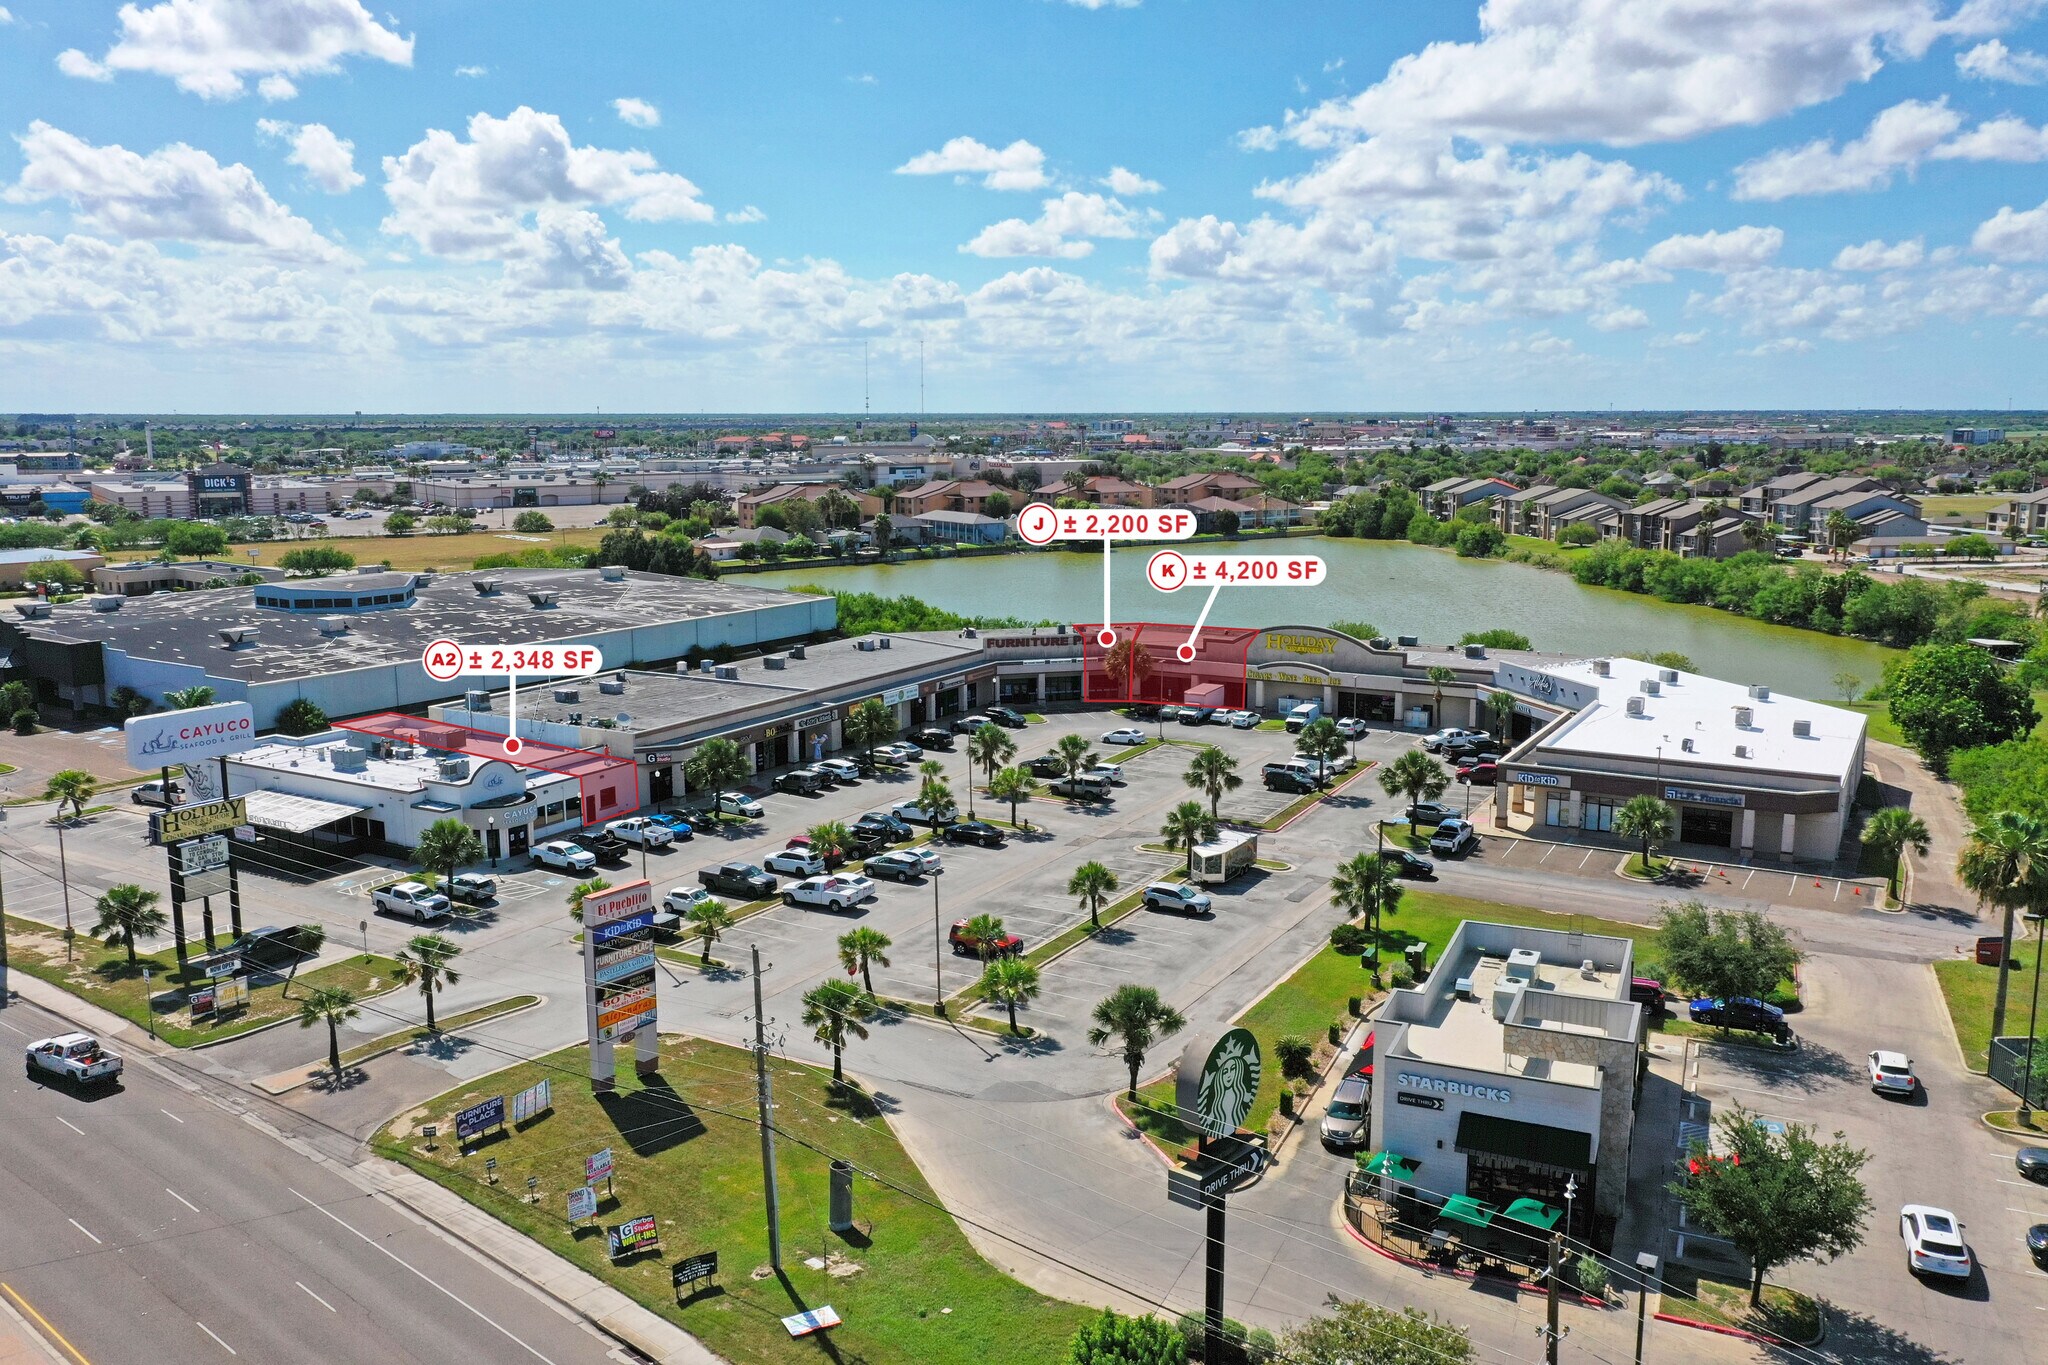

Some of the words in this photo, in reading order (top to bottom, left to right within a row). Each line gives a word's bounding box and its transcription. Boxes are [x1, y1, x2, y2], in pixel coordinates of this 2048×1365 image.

[204, 476, 236, 488] DICK'S
[986, 637, 1069, 649] FURNITURE
[1265, 633, 1339, 654] HOLIDAY
[1277, 671, 1298, 682] WINE
[1303, 675, 1323, 686] BEER
[179, 718, 250, 740] CAYUCO
[765, 728, 776, 738] BO
[180, 738, 217, 750] SEAFOOD
[229, 732, 252, 742] GRILL
[647, 754, 656, 763] G
[161, 799, 243, 834] HOLIDAY
[213, 823, 228, 831] BEER
[187, 844, 209, 853] COOLEST
[597, 903, 607, 916] El
[609, 892, 647, 914] Pueblito
[596, 947, 632, 966] FURNITURE
[221, 961, 235, 971] OPEN
[190, 996, 199, 1004] G
[603, 996, 620, 1008] BO
[1397, 1073, 1511, 1103] STARBUCKS
[1399, 1095, 1416, 1103] DRIVE
[1417, 1098, 1433, 1106] THRU
[456, 1097, 503, 1123] FURNITURE
[468, 1108, 496, 1126] PLACE
[1204, 1173, 1228, 1196] DRIVE
[1229, 1160, 1250, 1180] THRU
[632, 1216, 654, 1225] Barber
[622, 1225, 632, 1237] G
[633, 1223, 655, 1233] Studio
[621, 1229, 657, 1247] WALK-INS
